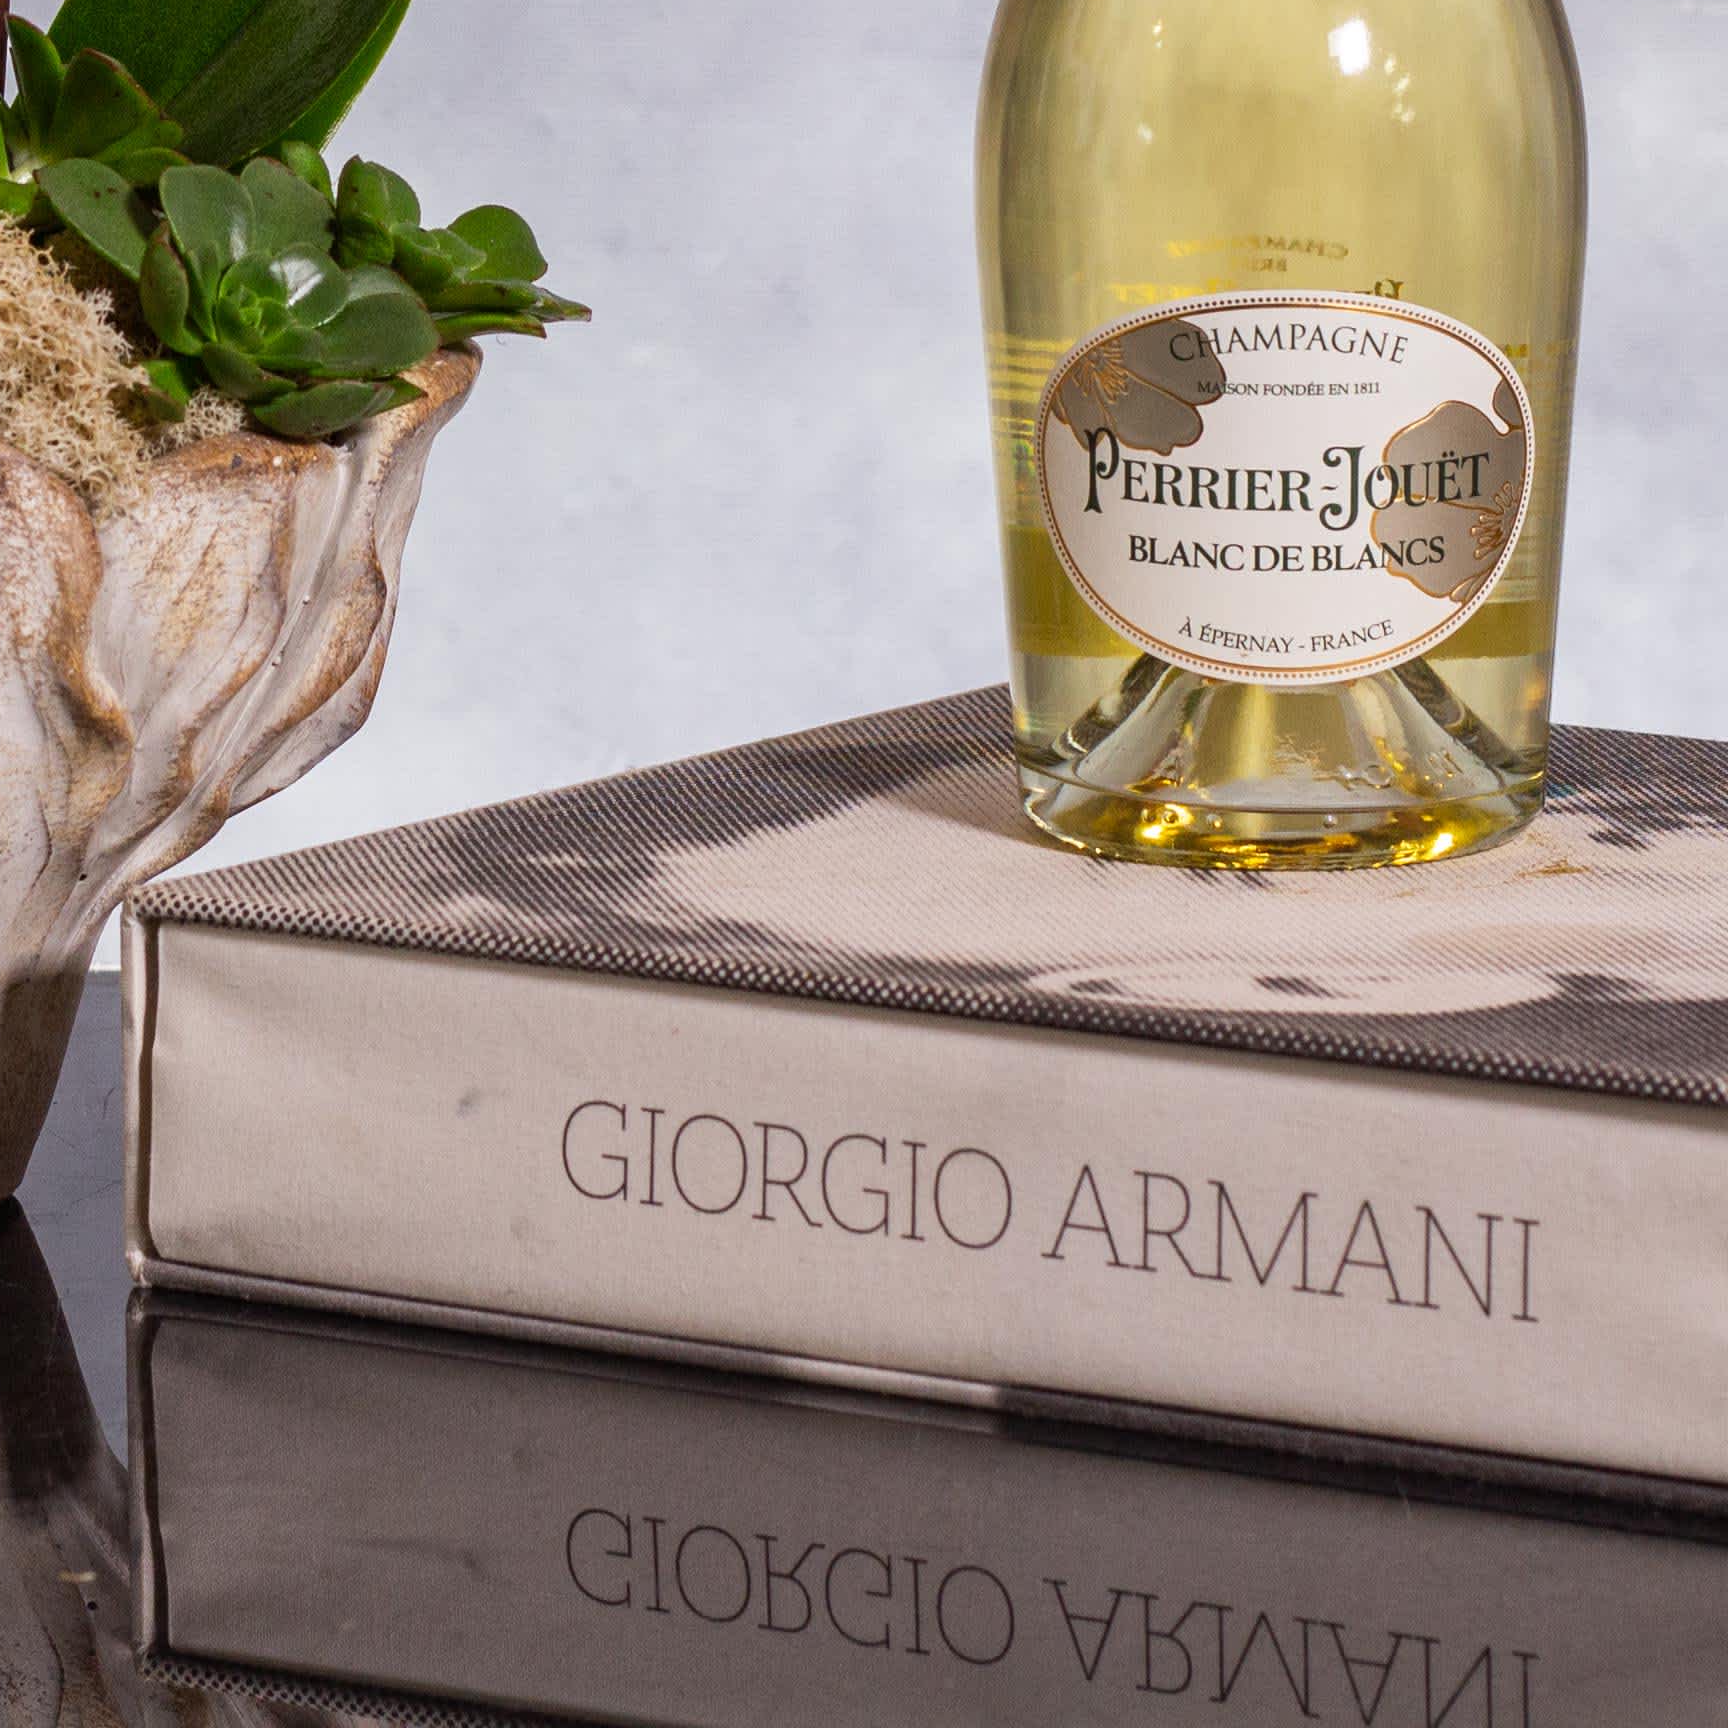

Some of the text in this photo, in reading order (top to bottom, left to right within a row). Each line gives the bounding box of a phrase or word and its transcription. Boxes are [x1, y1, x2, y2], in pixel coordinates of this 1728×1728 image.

[1168, 322, 1410, 366] CHAMPAGNE
[1197, 380, 1381, 397] MAISON FONDÉE EN 1811
[1082, 426, 1491, 532] PERRIER-JOUËT
[1127, 533, 1446, 573] BLANC DE BLANCS
[1177, 615, 1193, 638] À
[1198, 622, 1295, 654] ÉPERNAY
[1310, 619, 1395, 653] FRANCE
[560, 1099, 1542, 1324] GIORGIO ARMANI
